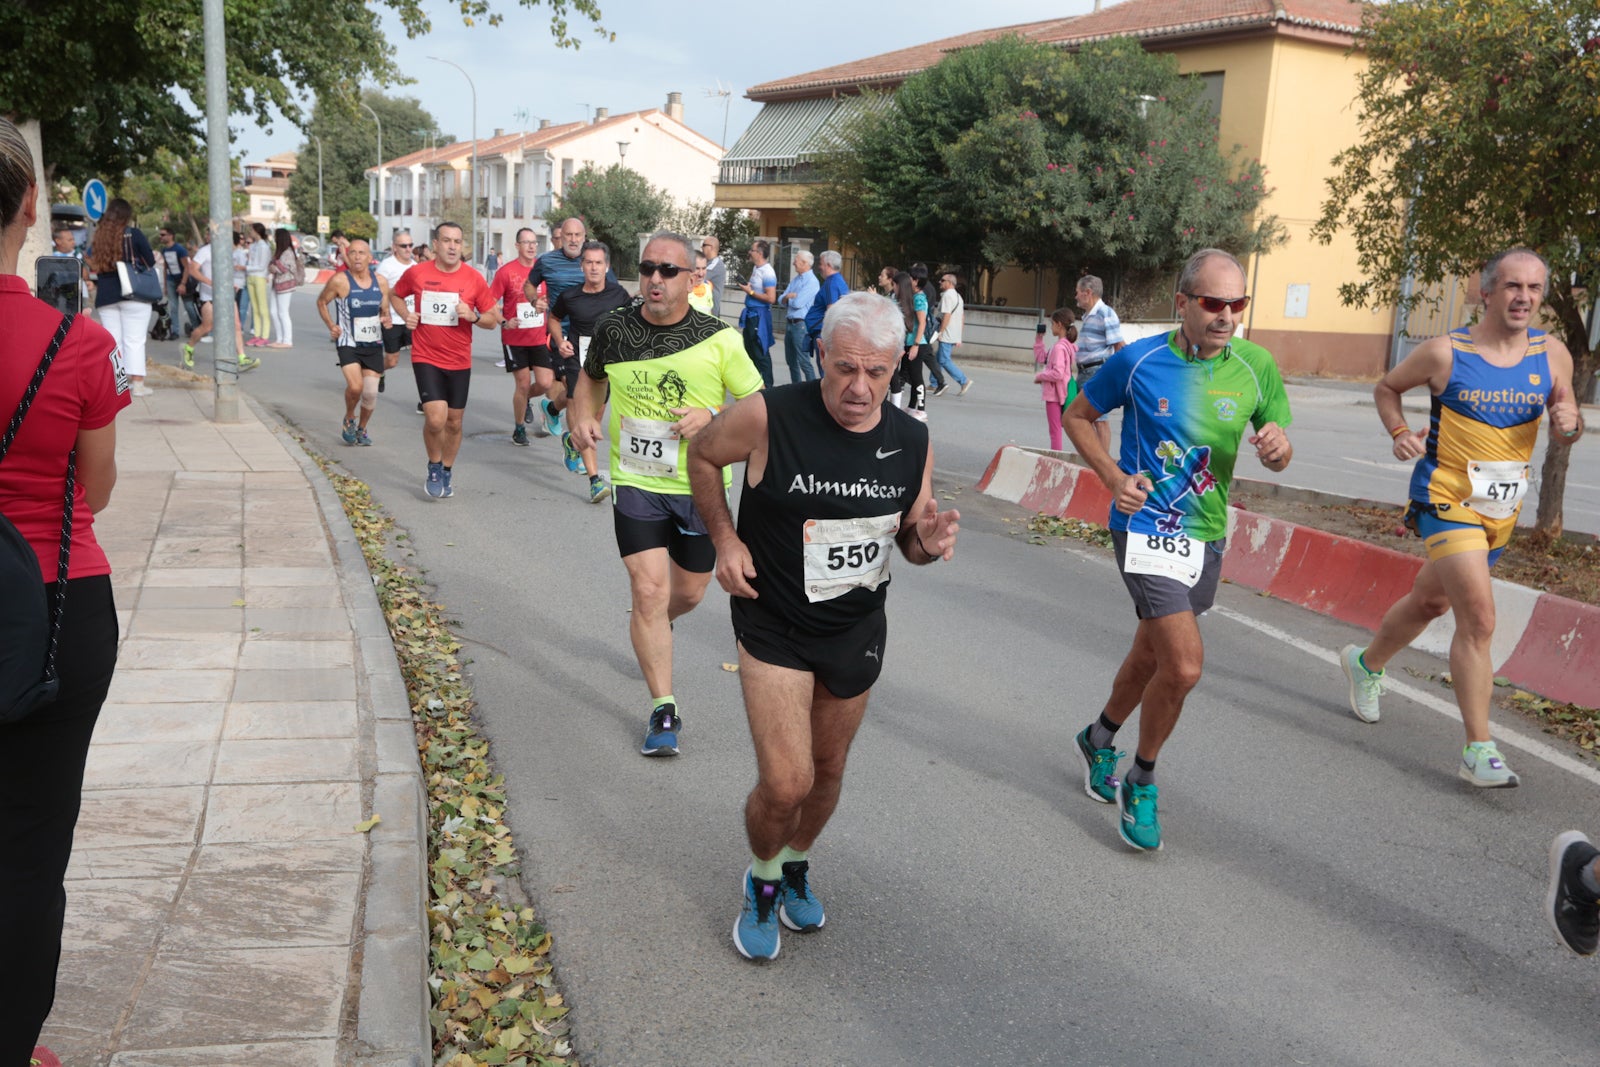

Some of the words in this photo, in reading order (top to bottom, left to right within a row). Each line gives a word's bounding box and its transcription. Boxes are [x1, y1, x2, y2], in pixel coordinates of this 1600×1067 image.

[432, 303, 447, 314] 92
[361, 325, 377, 334] 470
[631, 370, 649, 385] XI
[626, 384, 654, 393] Prueba
[1458, 388, 1545, 407] agustinos
[634, 406, 680, 420] ROMA
[1471, 405, 1532, 414] GRANADA
[630, 436, 663, 459] 573
[788, 473, 907, 499] Almuñécar
[1487, 482, 1519, 500] 477
[1146, 534, 1191, 558] 863
[827, 541, 880, 571] 550
